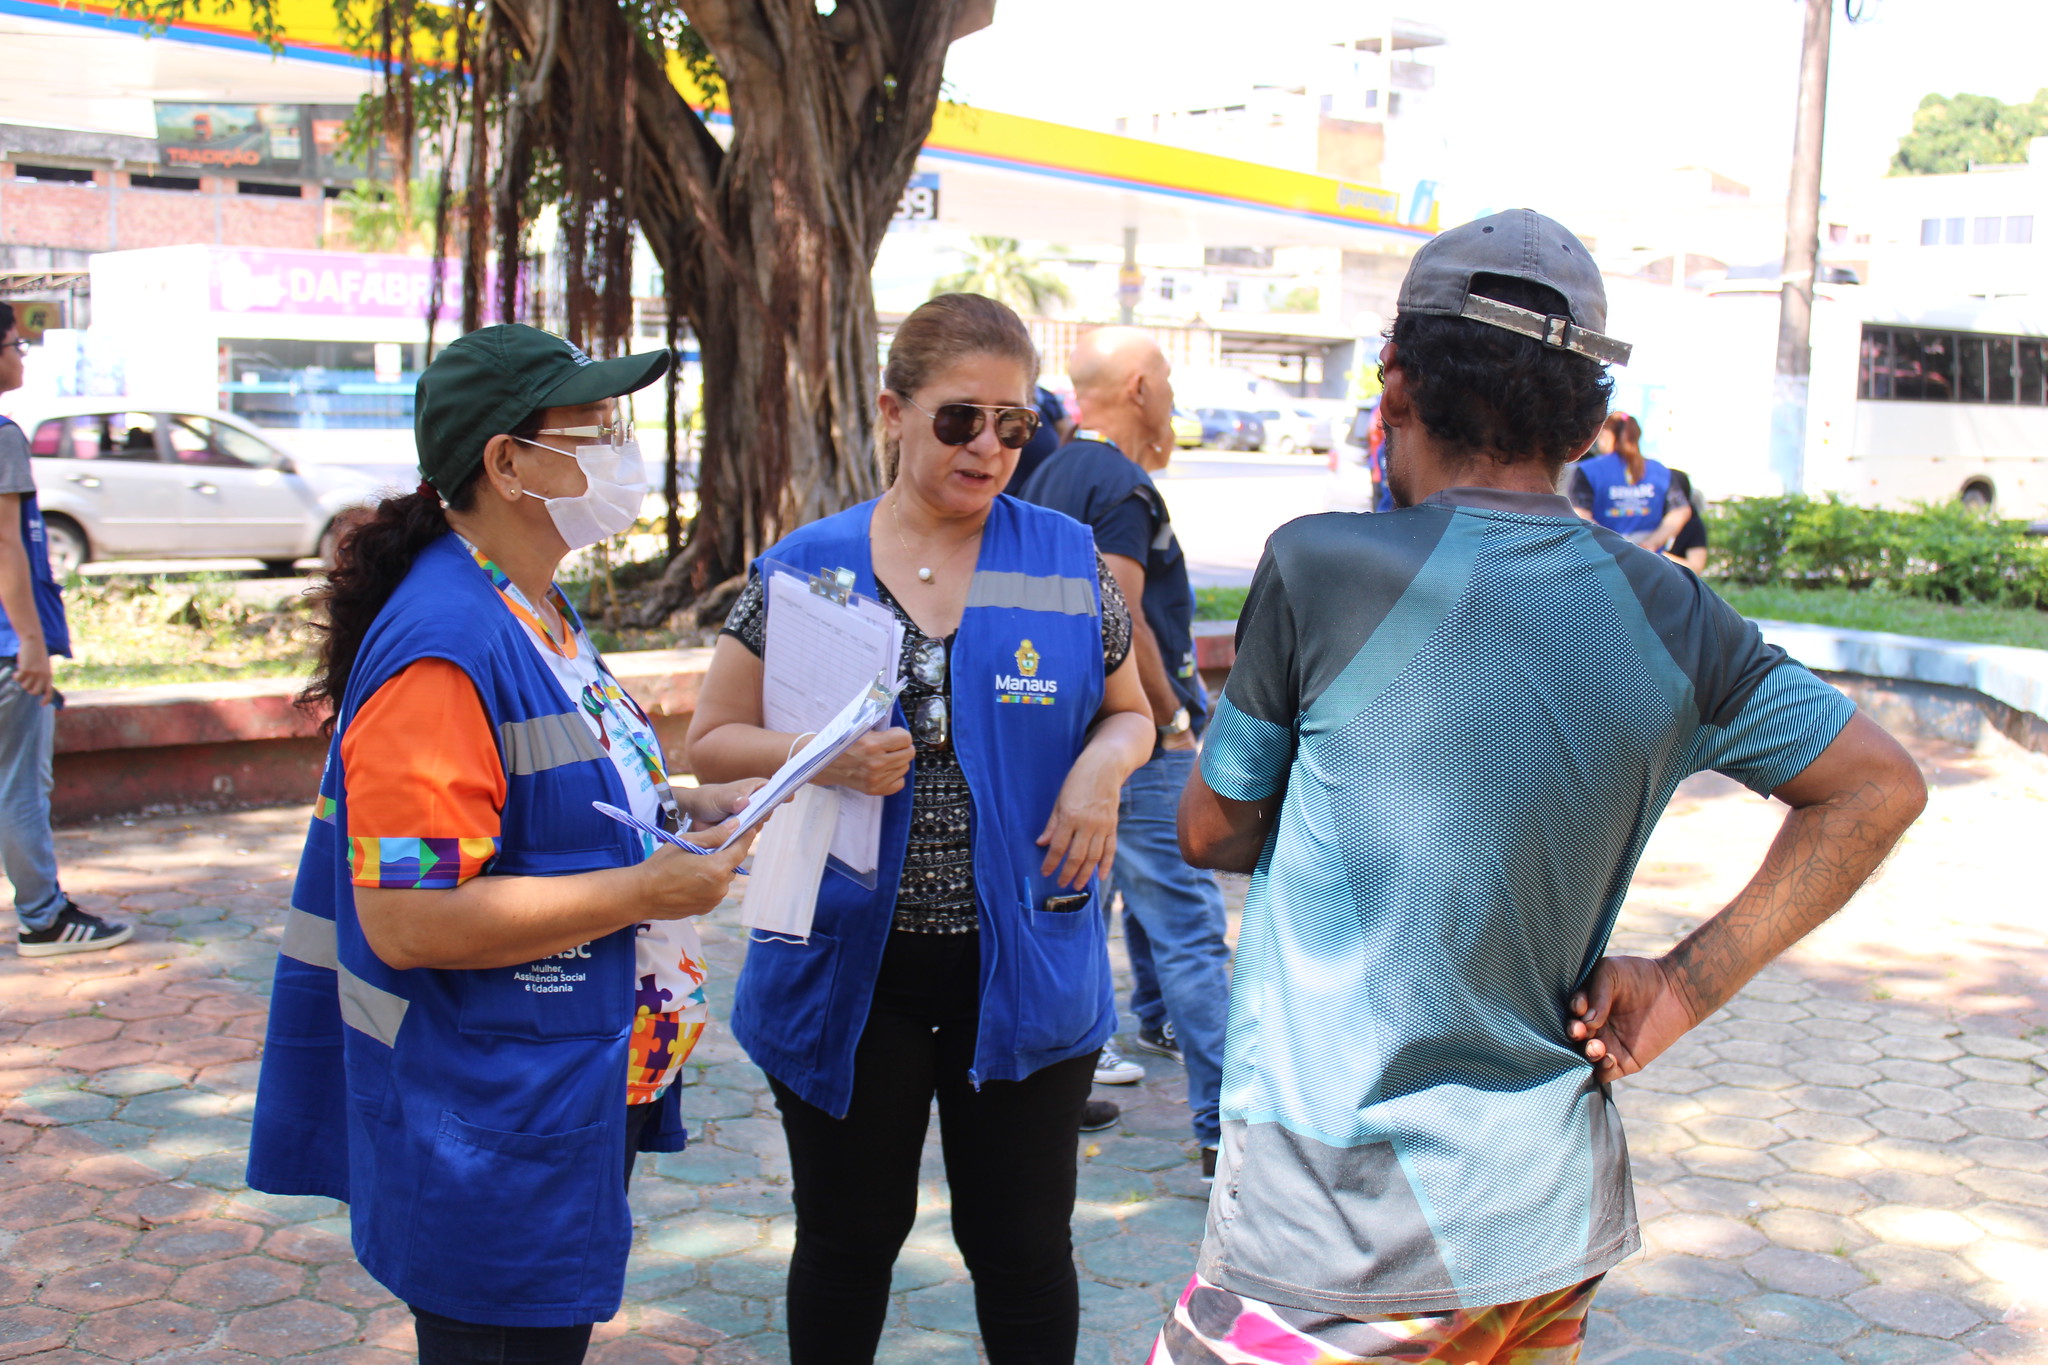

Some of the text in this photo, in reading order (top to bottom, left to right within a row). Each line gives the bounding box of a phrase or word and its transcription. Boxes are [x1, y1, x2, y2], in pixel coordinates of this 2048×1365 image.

[995, 674, 1058, 693] Manaus
[531, 965, 564, 973] Mulher,
[513, 972, 586, 982] Assiência Social
